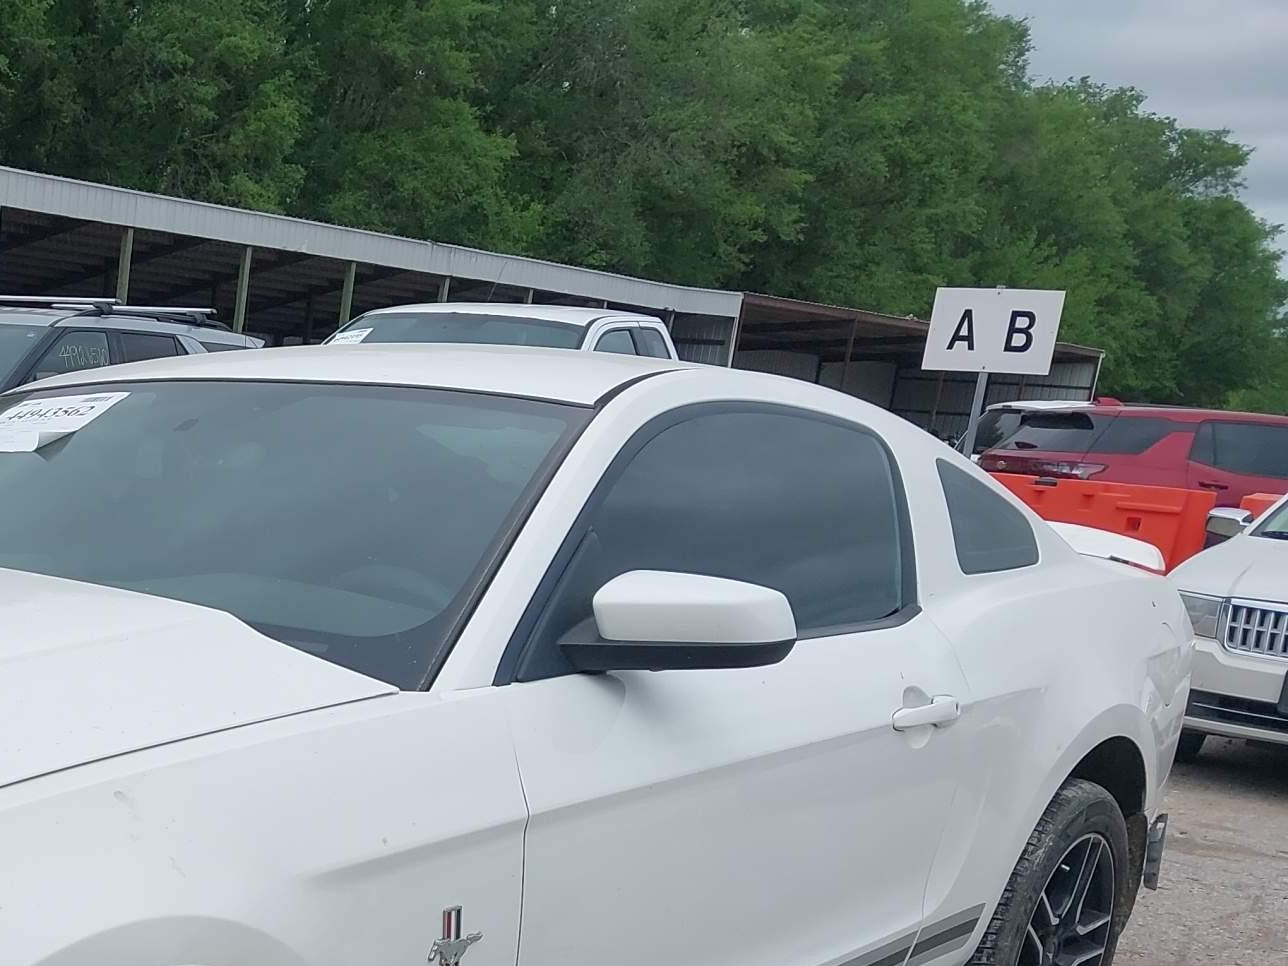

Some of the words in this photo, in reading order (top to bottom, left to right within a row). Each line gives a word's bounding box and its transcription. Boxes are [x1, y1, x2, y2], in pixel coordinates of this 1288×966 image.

[946, 309, 975, 351] A
[1003, 310, 1037, 353] B
[8, 405, 96, 421] 44943562
